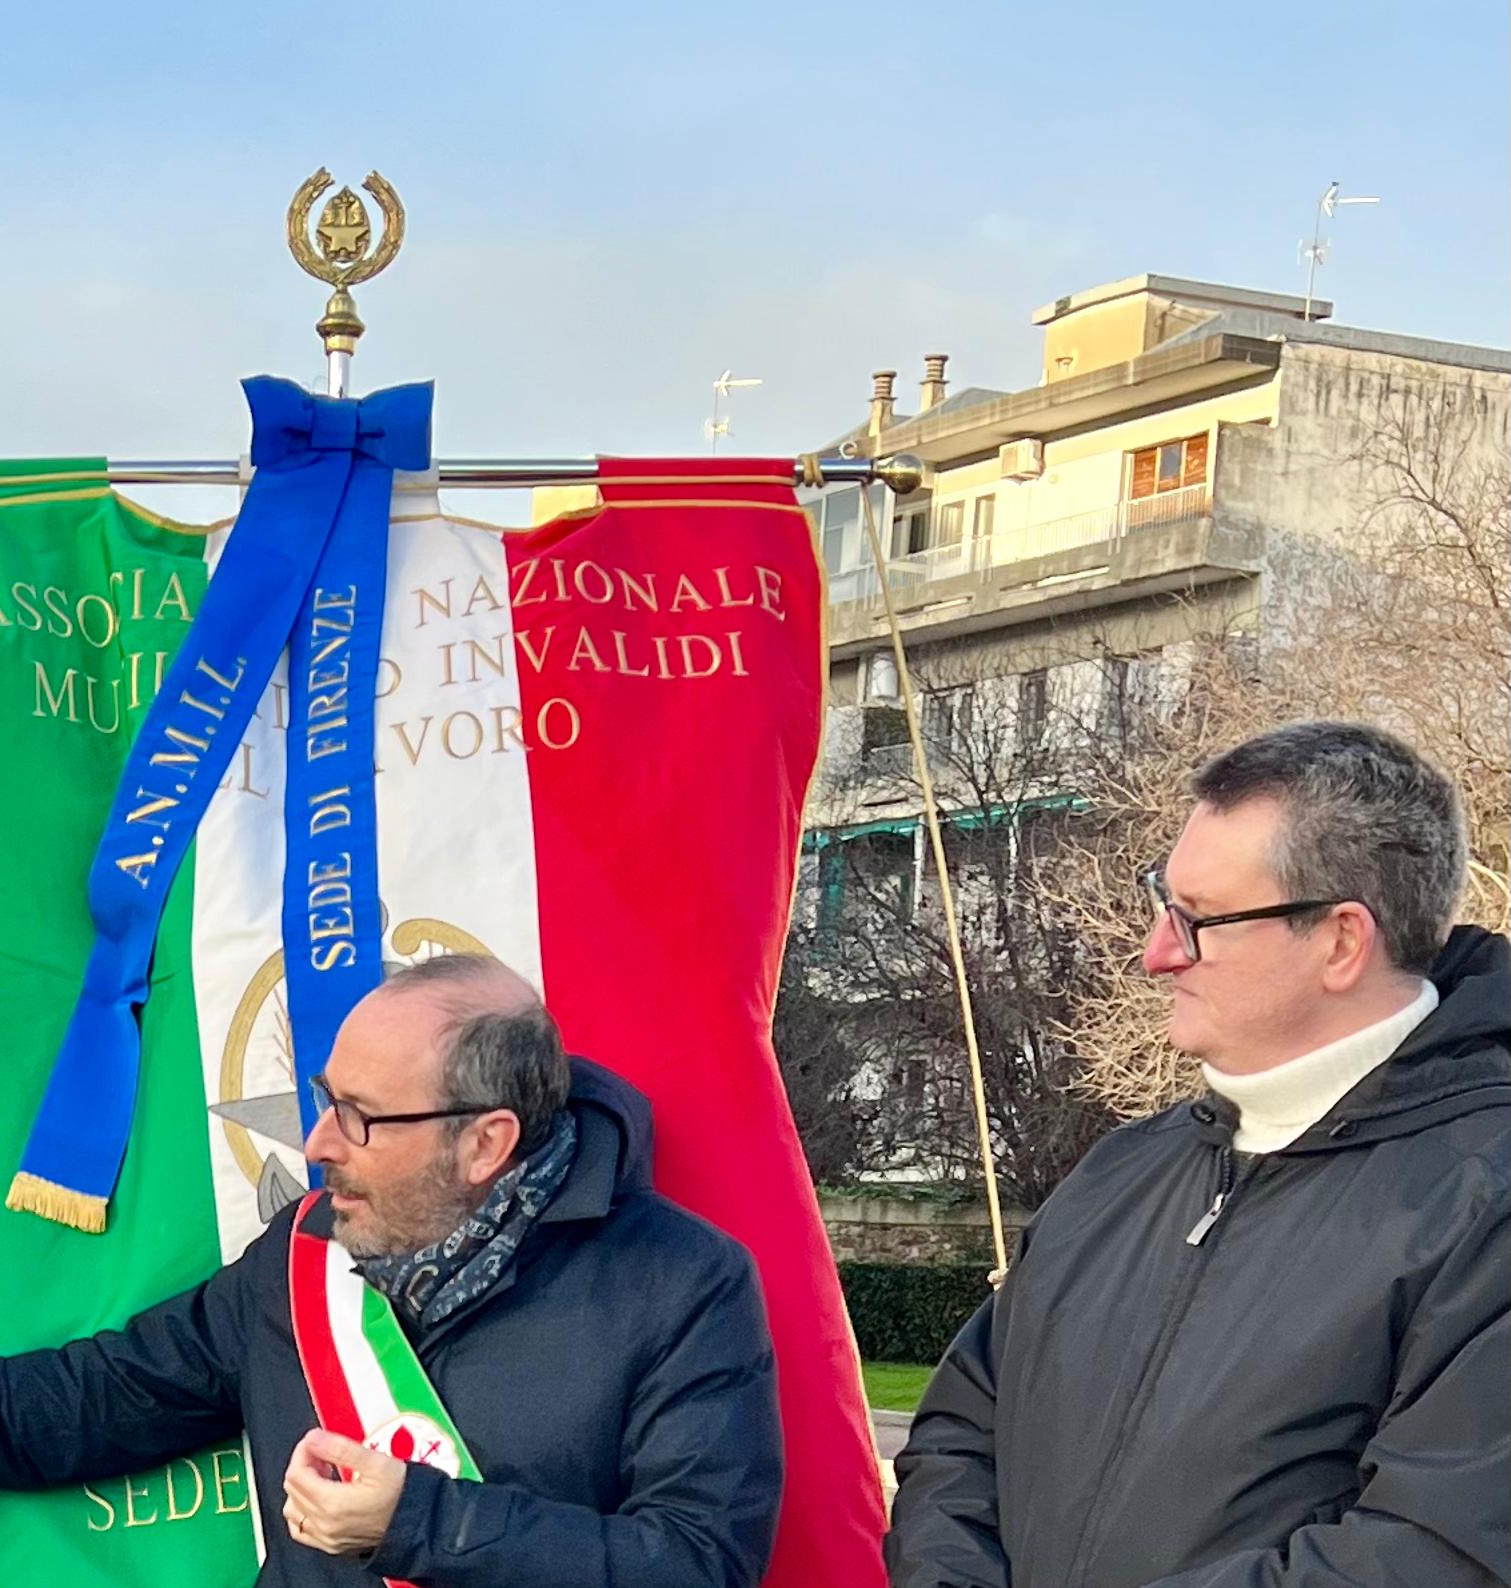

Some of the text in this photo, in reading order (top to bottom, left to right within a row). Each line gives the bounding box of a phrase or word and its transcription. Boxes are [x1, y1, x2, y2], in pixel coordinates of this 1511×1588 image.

[412, 558, 787, 629] NAZIONALE
[438, 625, 750, 687] INVALIDI
[115, 656, 248, 890] A.N.M.I.L.
[306, 584, 357, 971] SEDE DI FIRENZE
[83, 1449, 249, 1532] SEDE
